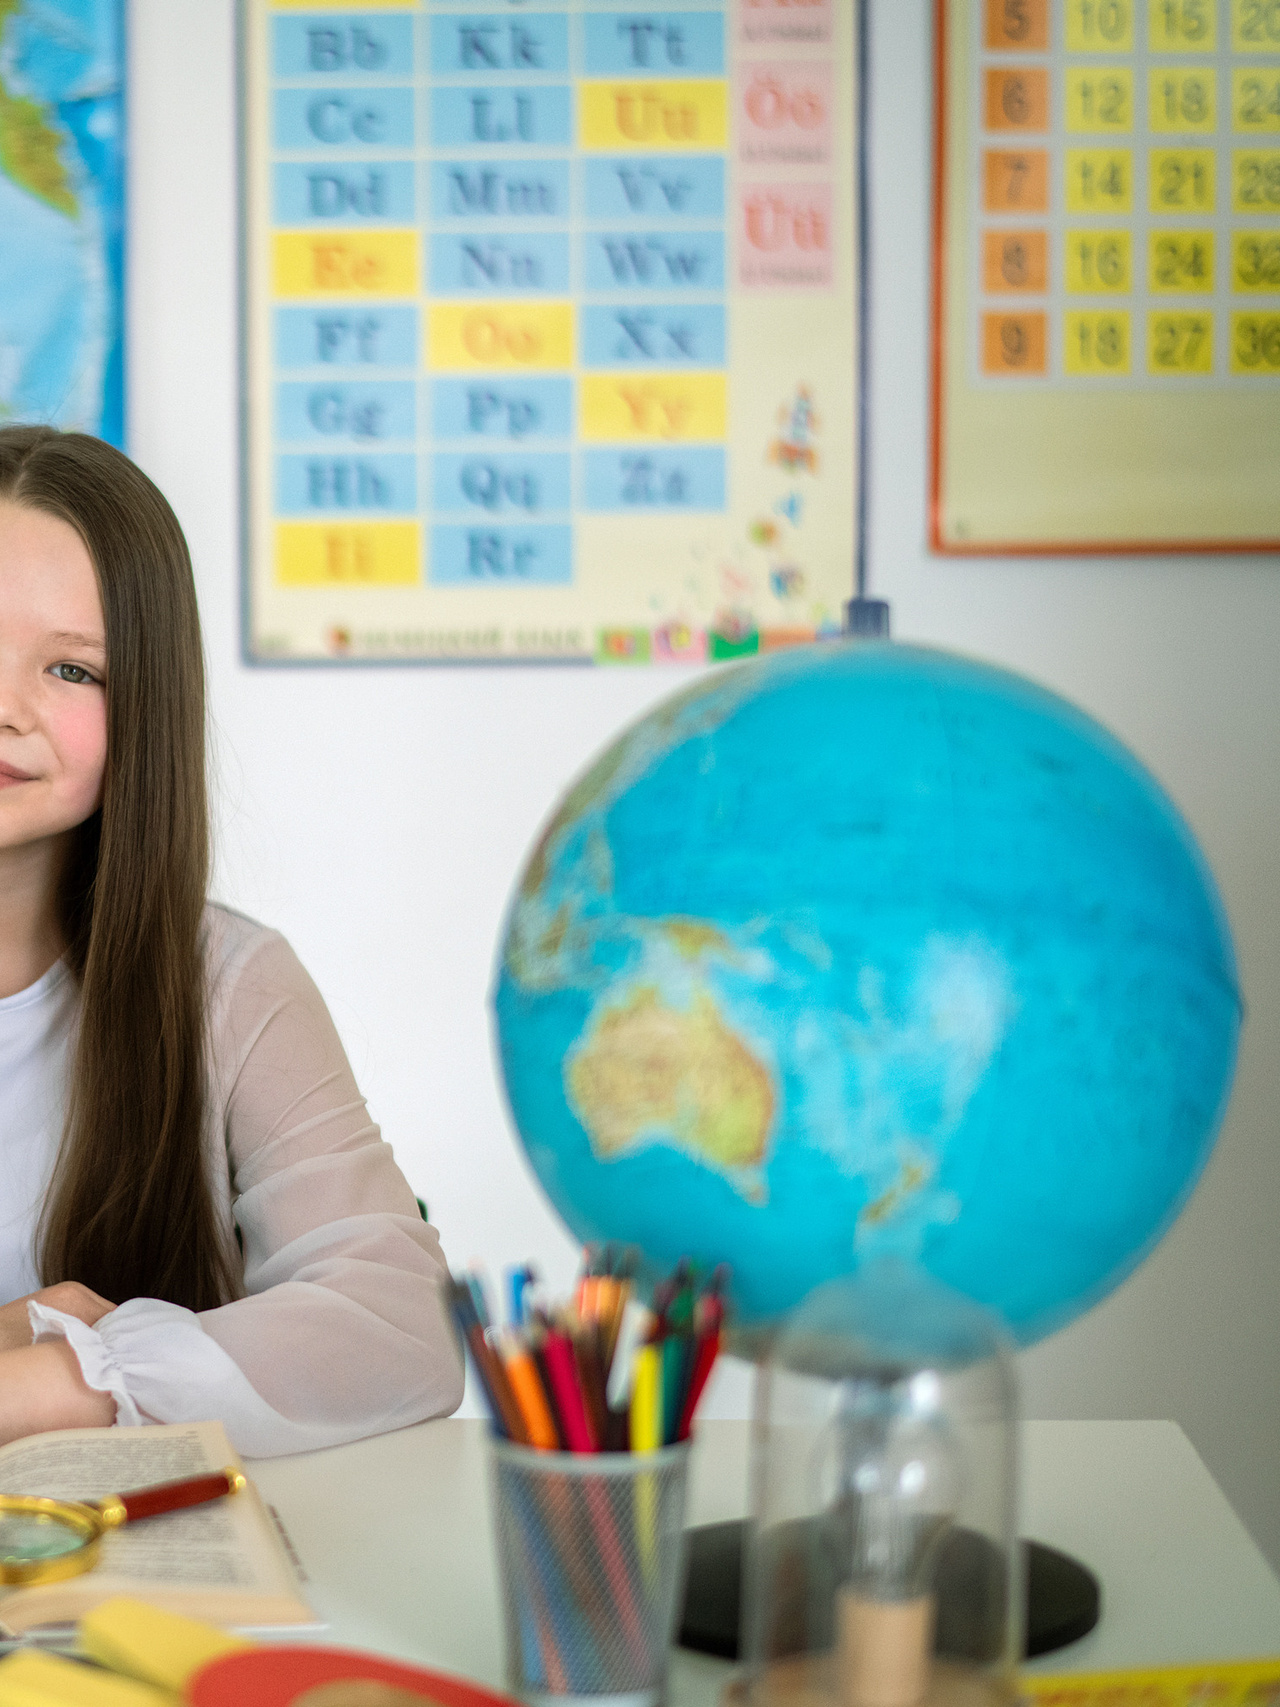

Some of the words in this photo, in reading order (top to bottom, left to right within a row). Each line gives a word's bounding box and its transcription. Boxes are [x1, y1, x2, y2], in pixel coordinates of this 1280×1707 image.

[1003, 0, 1031, 41] 5
[1081, 0, 1126, 41] 10
[1164, 0, 1208, 41] 15
[305, 25, 389, 72] Bb
[458, 24, 545, 70] Kk
[617, 21, 689, 68] Tt
[307, 97, 387, 143] Cc
[470, 94, 535, 142] Ll
[615, 88, 700, 142] Uu
[1002, 76, 1029, 124] 6
[1081, 76, 1125, 124] 12
[1164, 76, 1208, 123] 18
[305, 172, 389, 217] Dd
[448, 170, 558, 216] Mm
[616, 166, 692, 212] Vv
[1004, 156, 1030, 203] 7
[1081, 159, 1125, 203] 14
[1159, 158, 1205, 204] 21
[310, 242, 382, 289] Ee
[461, 242, 544, 287] Nn
[604, 239, 702, 285] Ww
[1080, 238, 1125, 286] 16
[1155, 238, 1205, 286] 24
[315, 315, 382, 362] Ff
[461, 310, 542, 364] Oo
[616, 311, 694, 360] Xx
[1000, 317, 1028, 366] 9
[1079, 318, 1125, 366] 18
[1154, 318, 1205, 366] 27
[305, 390, 384, 443] Gg
[465, 388, 541, 441] Pp
[618, 383, 693, 440] Yy
[305, 463, 388, 508] Hh
[460, 462, 539, 512] Qq
[467, 533, 537, 578] Rr
